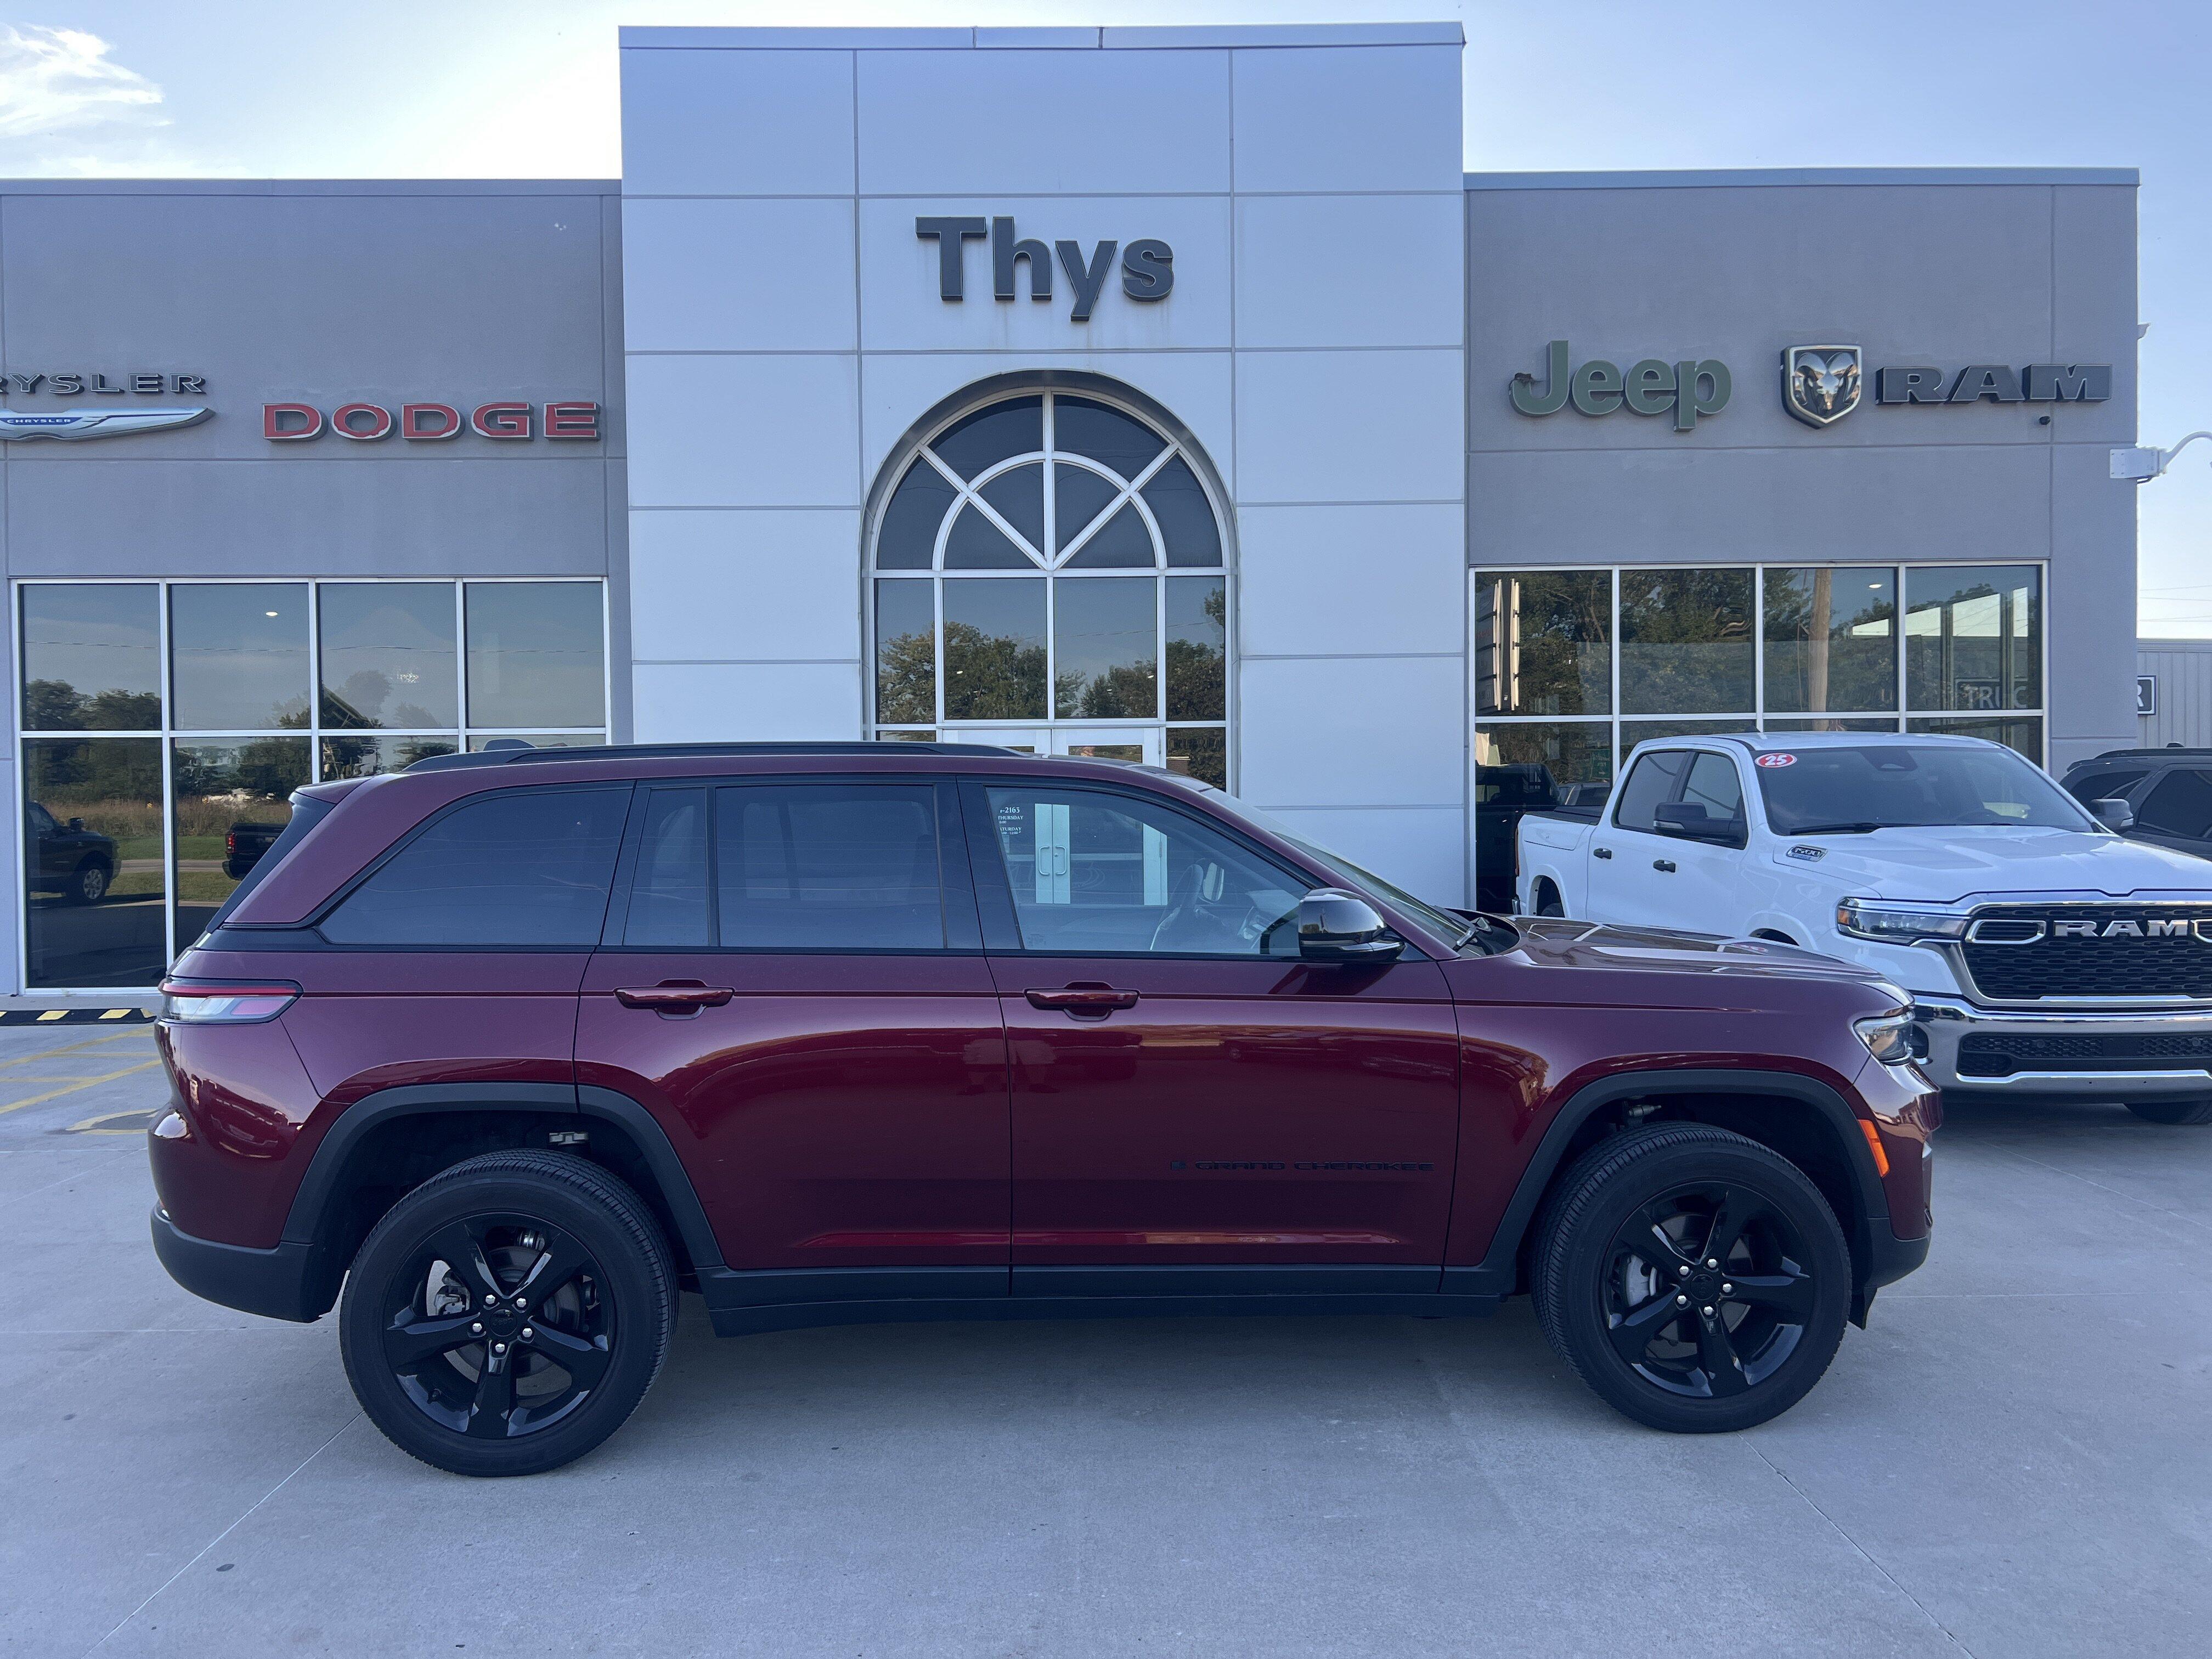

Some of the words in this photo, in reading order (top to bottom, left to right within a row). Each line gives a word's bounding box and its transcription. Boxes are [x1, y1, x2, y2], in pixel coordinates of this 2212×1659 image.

[916, 217, 1174, 321] Thys
[0, 373, 206, 394] YSLER
[1509, 340, 1732, 432] Jeep
[1876, 363, 2112, 405] RAM
[262, 402, 600, 441] DODGE
[1764, 754, 1788, 766] 25
[2053, 919, 2189, 937] RAM
[1195, 1160, 1285, 1171] GRAND
[1294, 1161, 1435, 1171] CHEROKEE
